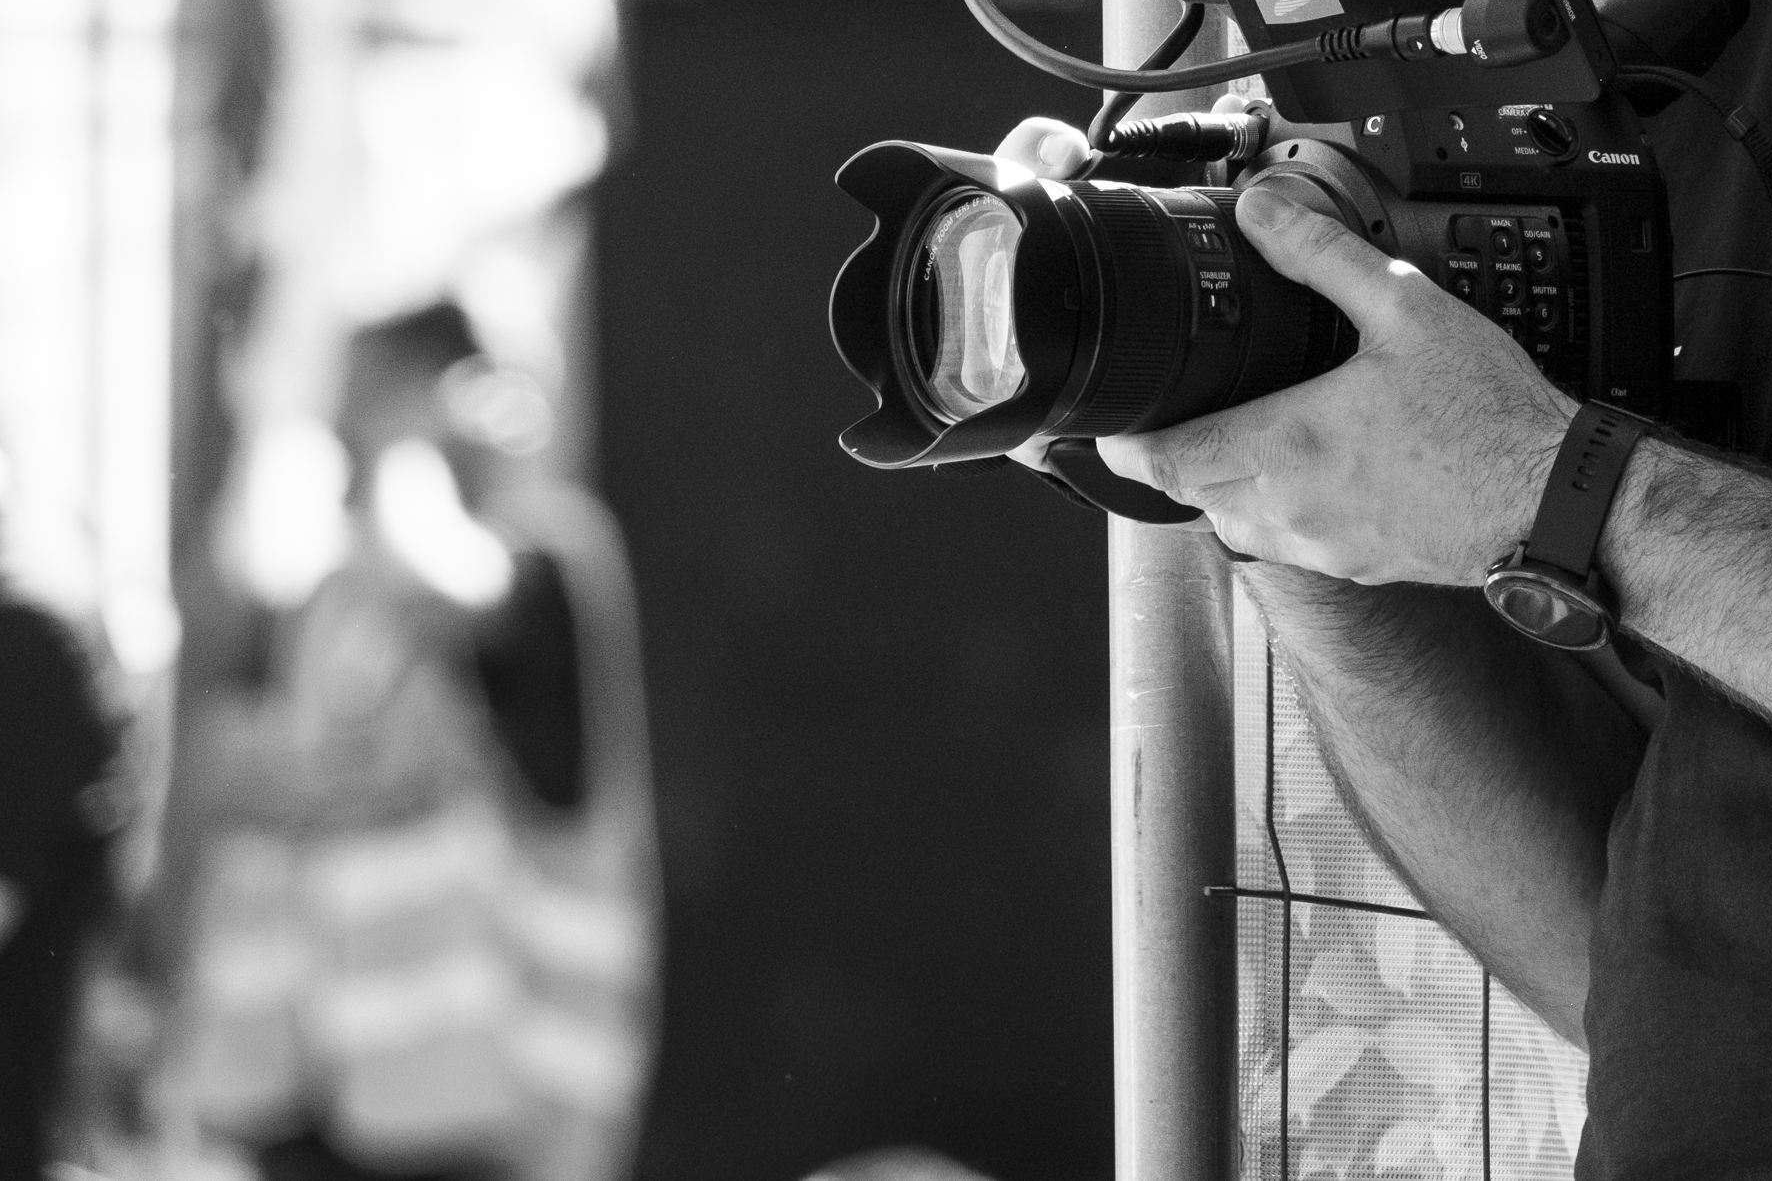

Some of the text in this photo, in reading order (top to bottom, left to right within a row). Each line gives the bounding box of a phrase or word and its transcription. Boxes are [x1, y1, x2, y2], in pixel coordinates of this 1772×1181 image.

[1473, 39, 1488, 60] VIDEO
[1366, 116, 1383, 133] C
[1511, 128, 1523, 136] OFF
[1514, 146, 1536, 156] MEDIA
[1588, 150, 1640, 165] Canon
[1463, 175, 1478, 186] 4K
[923, 245, 938, 281] CANON
[936, 216, 954, 243] ZOOM
[954, 202, 970, 219] LENS
[972, 197, 980, 207] EF
[1524, 230, 1551, 239] ISO/GAIN
[1502, 238, 1507, 248] 1
[1536, 251, 1542, 261] 5
[1449, 260, 1478, 269] ND FILTER
[1495, 263, 1522, 272] PEAKING
[1199, 271, 1231, 280] STABILIZER
[1201, 280, 1229, 289] ON OFF
[1507, 284, 1514, 294] 2
[1532, 286, 1557, 295] SHUTTER
[1502, 307, 1522, 316] ZEBRA
[1541, 308, 1548, 318] 6
